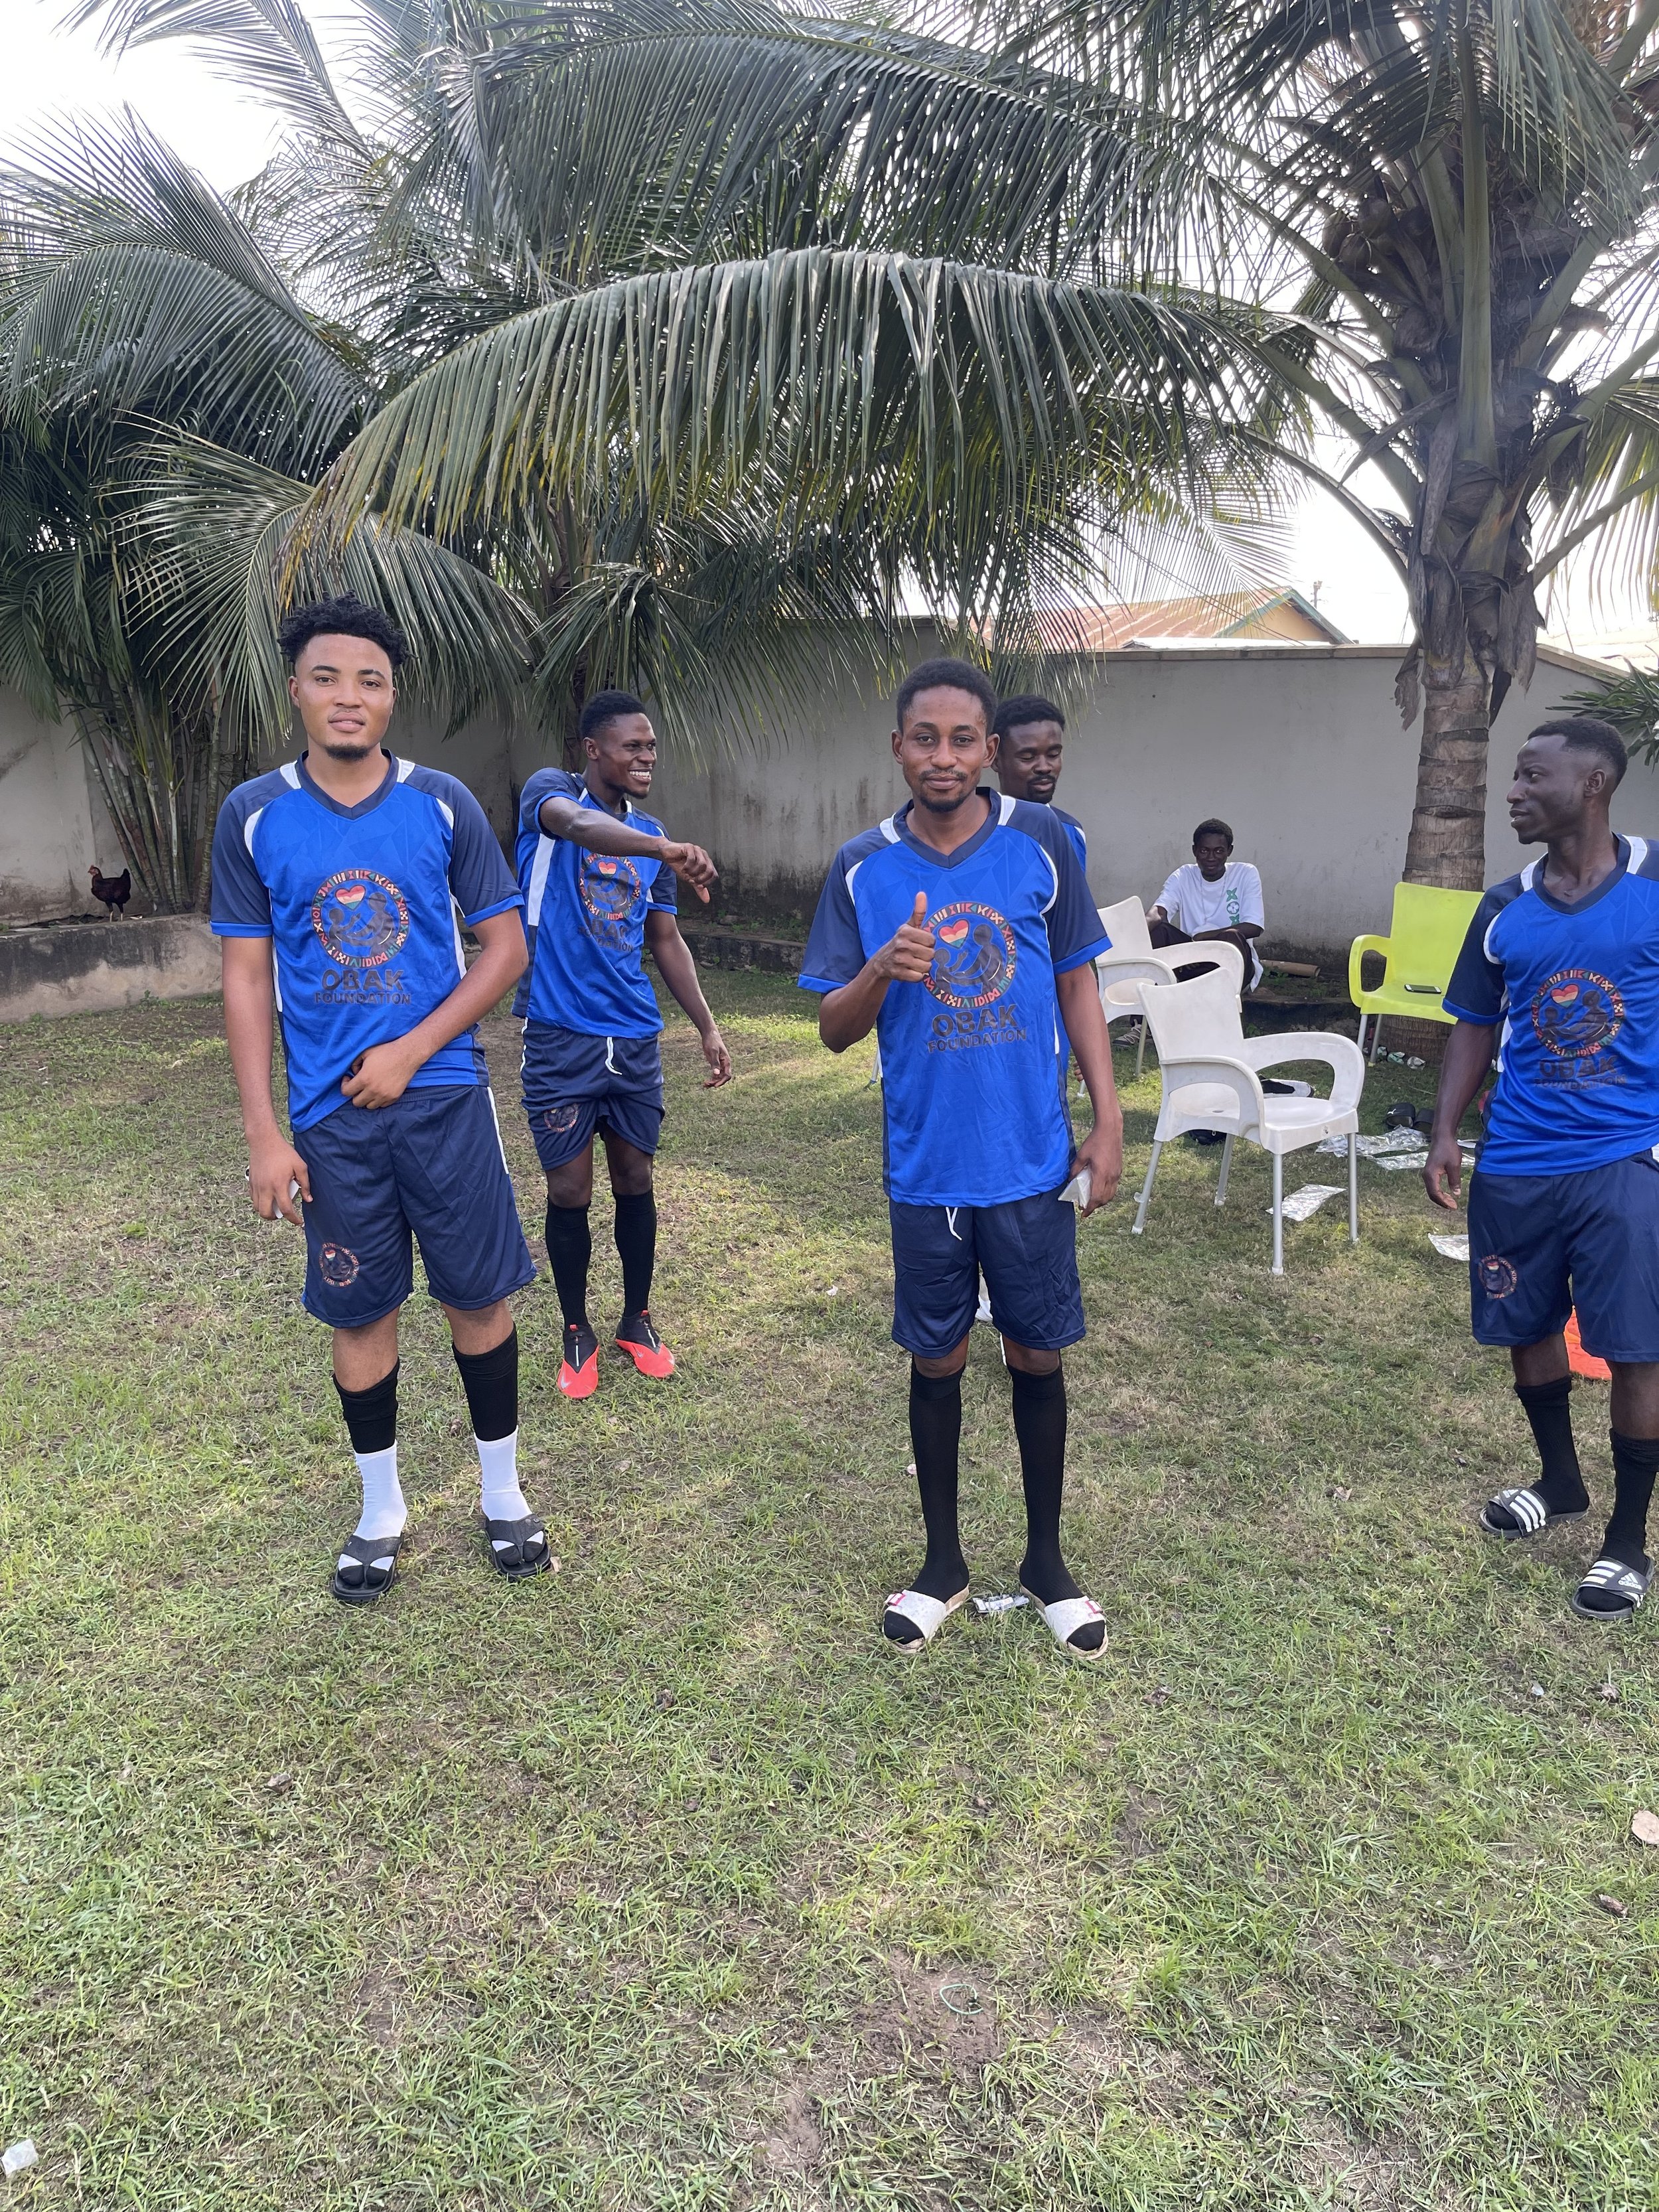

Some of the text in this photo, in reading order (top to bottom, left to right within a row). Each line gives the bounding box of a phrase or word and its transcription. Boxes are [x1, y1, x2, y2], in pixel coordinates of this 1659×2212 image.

[321, 969, 405, 991] OBAK
[315, 992, 411, 1005] FOUNDATION
[932, 1003, 1019, 1037] OBAK
[928, 1028, 1027, 1054] FOUNDATION
[1539, 1055, 1618, 1078] OBAK
[1618, 1580, 1643, 1590] adidas
